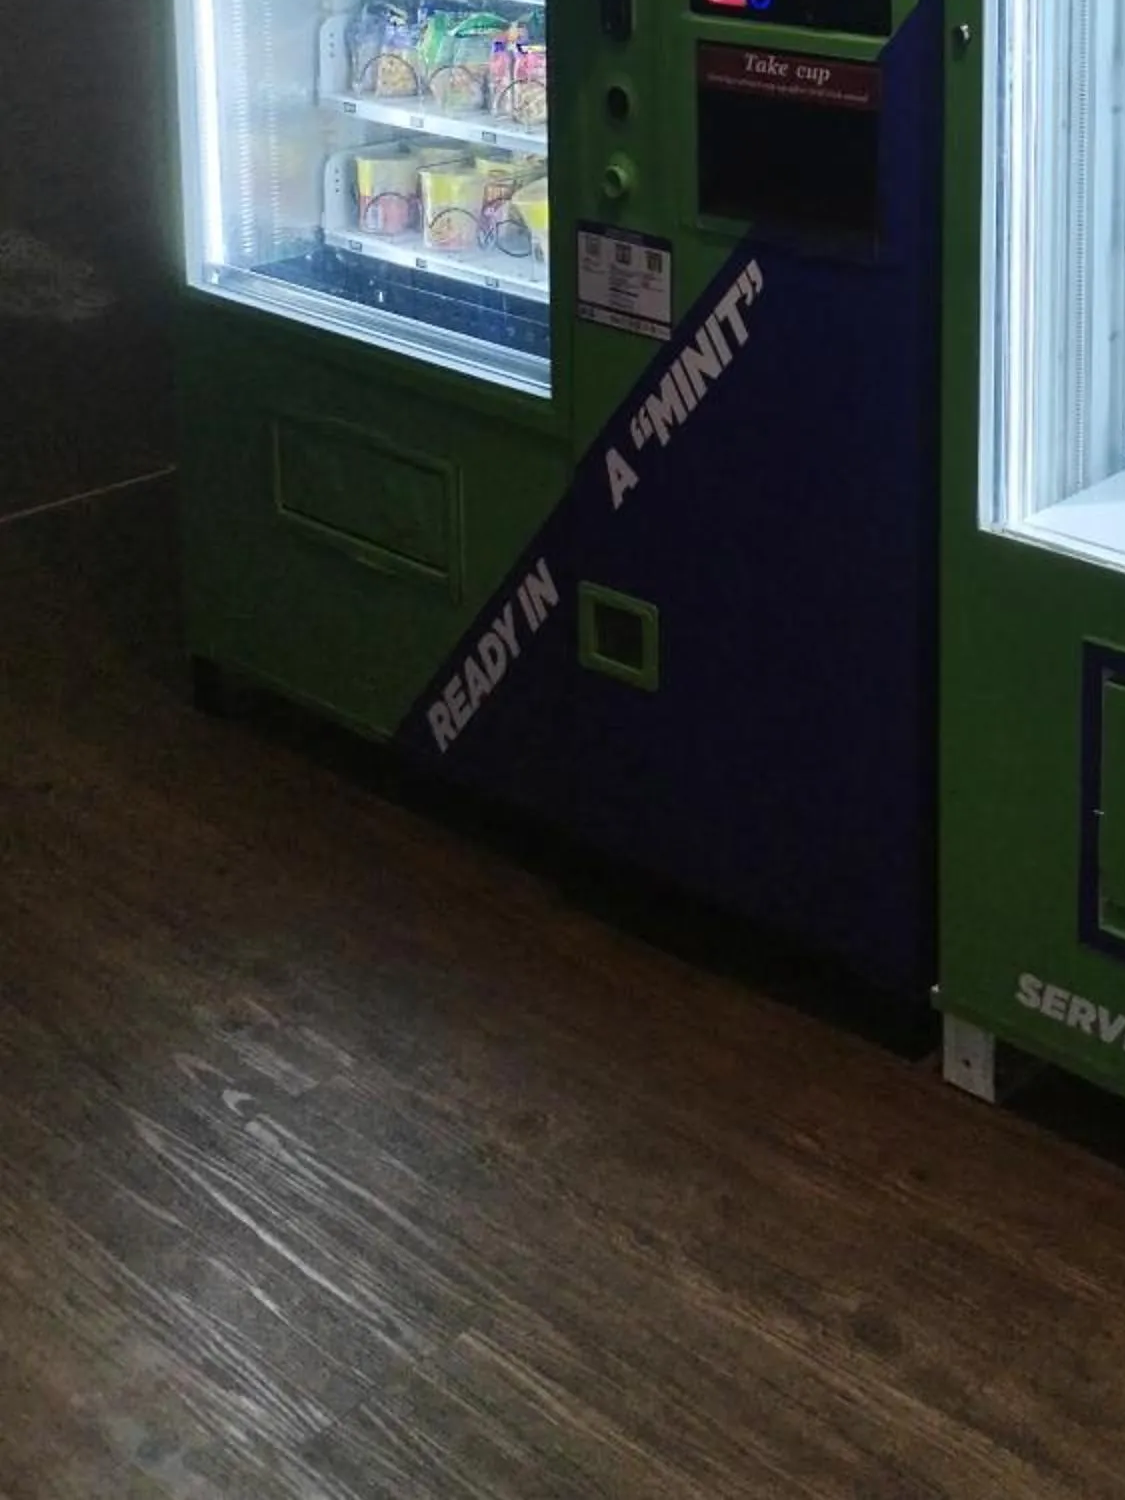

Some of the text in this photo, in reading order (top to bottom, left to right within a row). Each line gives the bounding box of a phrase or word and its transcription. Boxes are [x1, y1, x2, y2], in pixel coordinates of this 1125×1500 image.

[743, 52, 832, 86] Take cup
[426, 615, 521, 753] READY
[516, 557, 561, 637] IN
[604, 446, 641, 511] A
